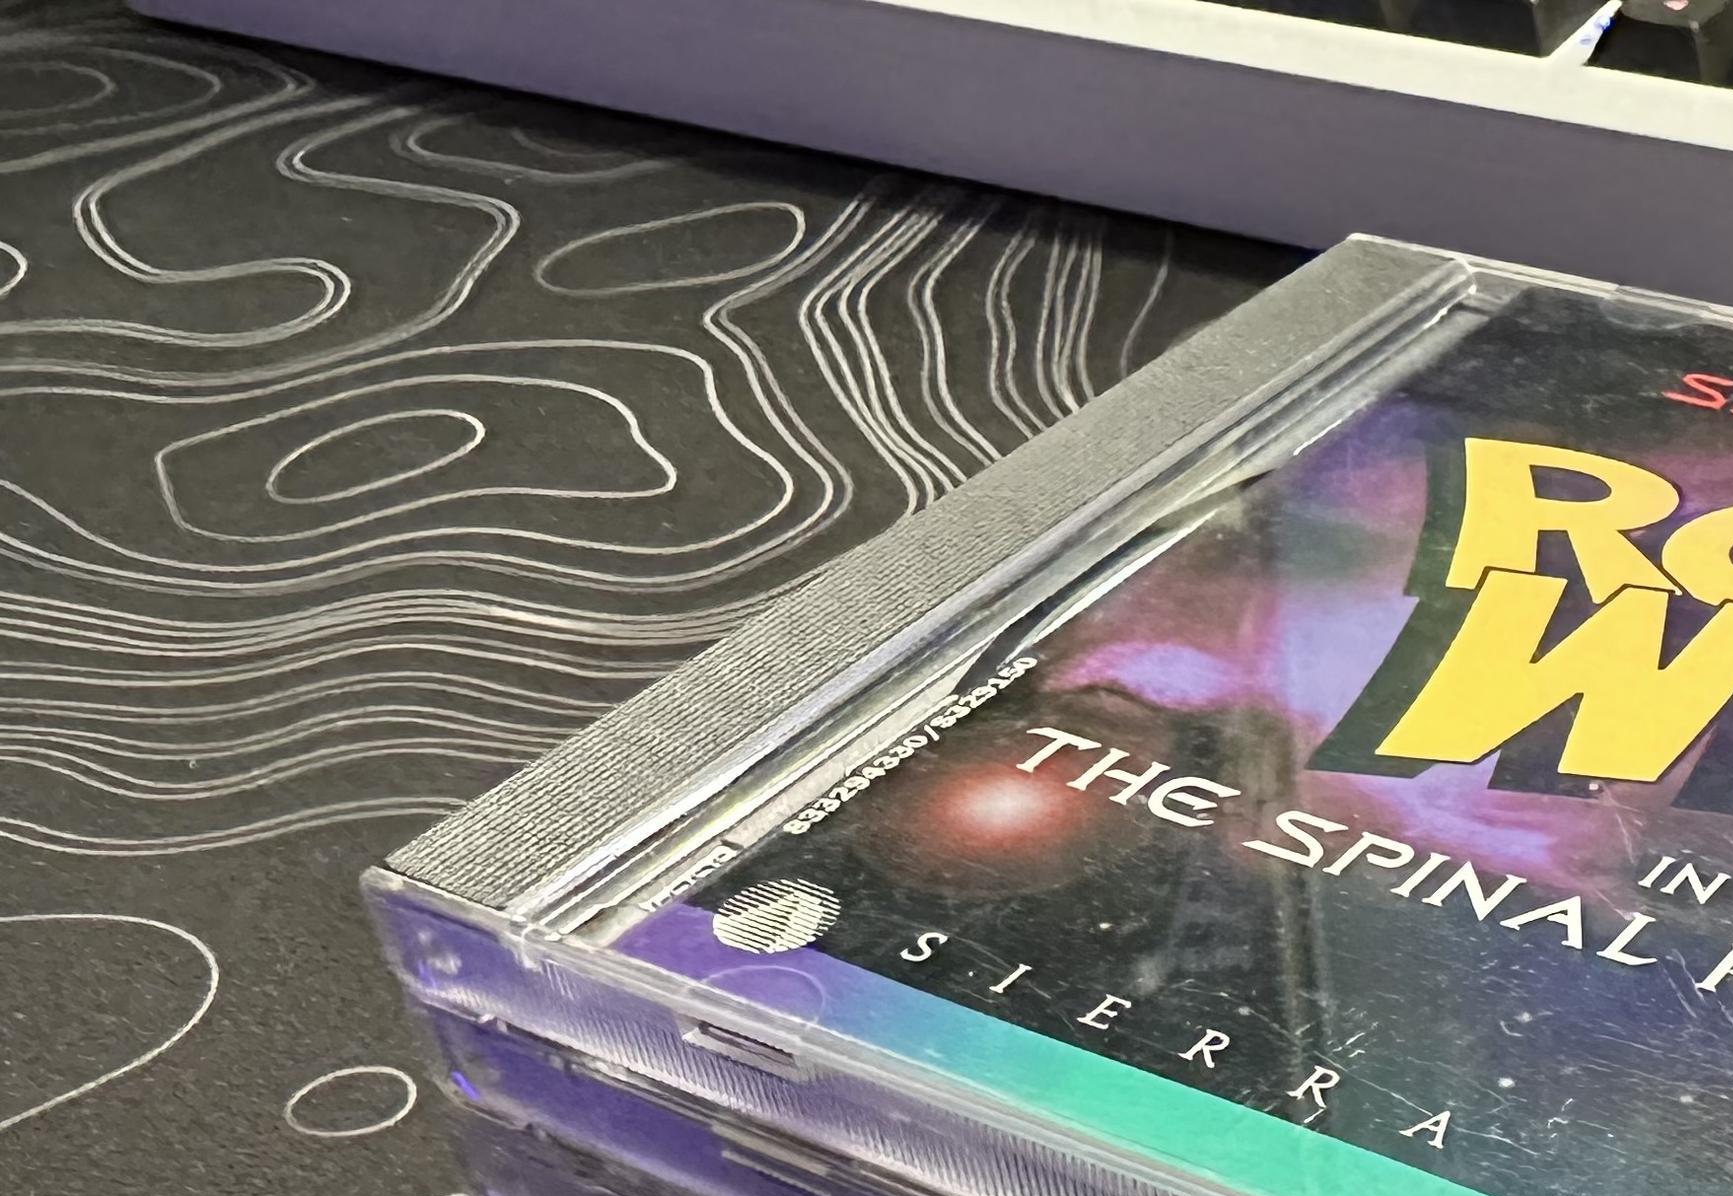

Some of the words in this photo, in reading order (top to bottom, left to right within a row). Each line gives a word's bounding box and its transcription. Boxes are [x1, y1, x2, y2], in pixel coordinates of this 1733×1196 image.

[1015, 726, 1241, 828] THE
[1241, 809, 1659, 966] SPINAL
[1637, 855, 1732, 905] IN
[899, 931, 1452, 1150] SIERRA
